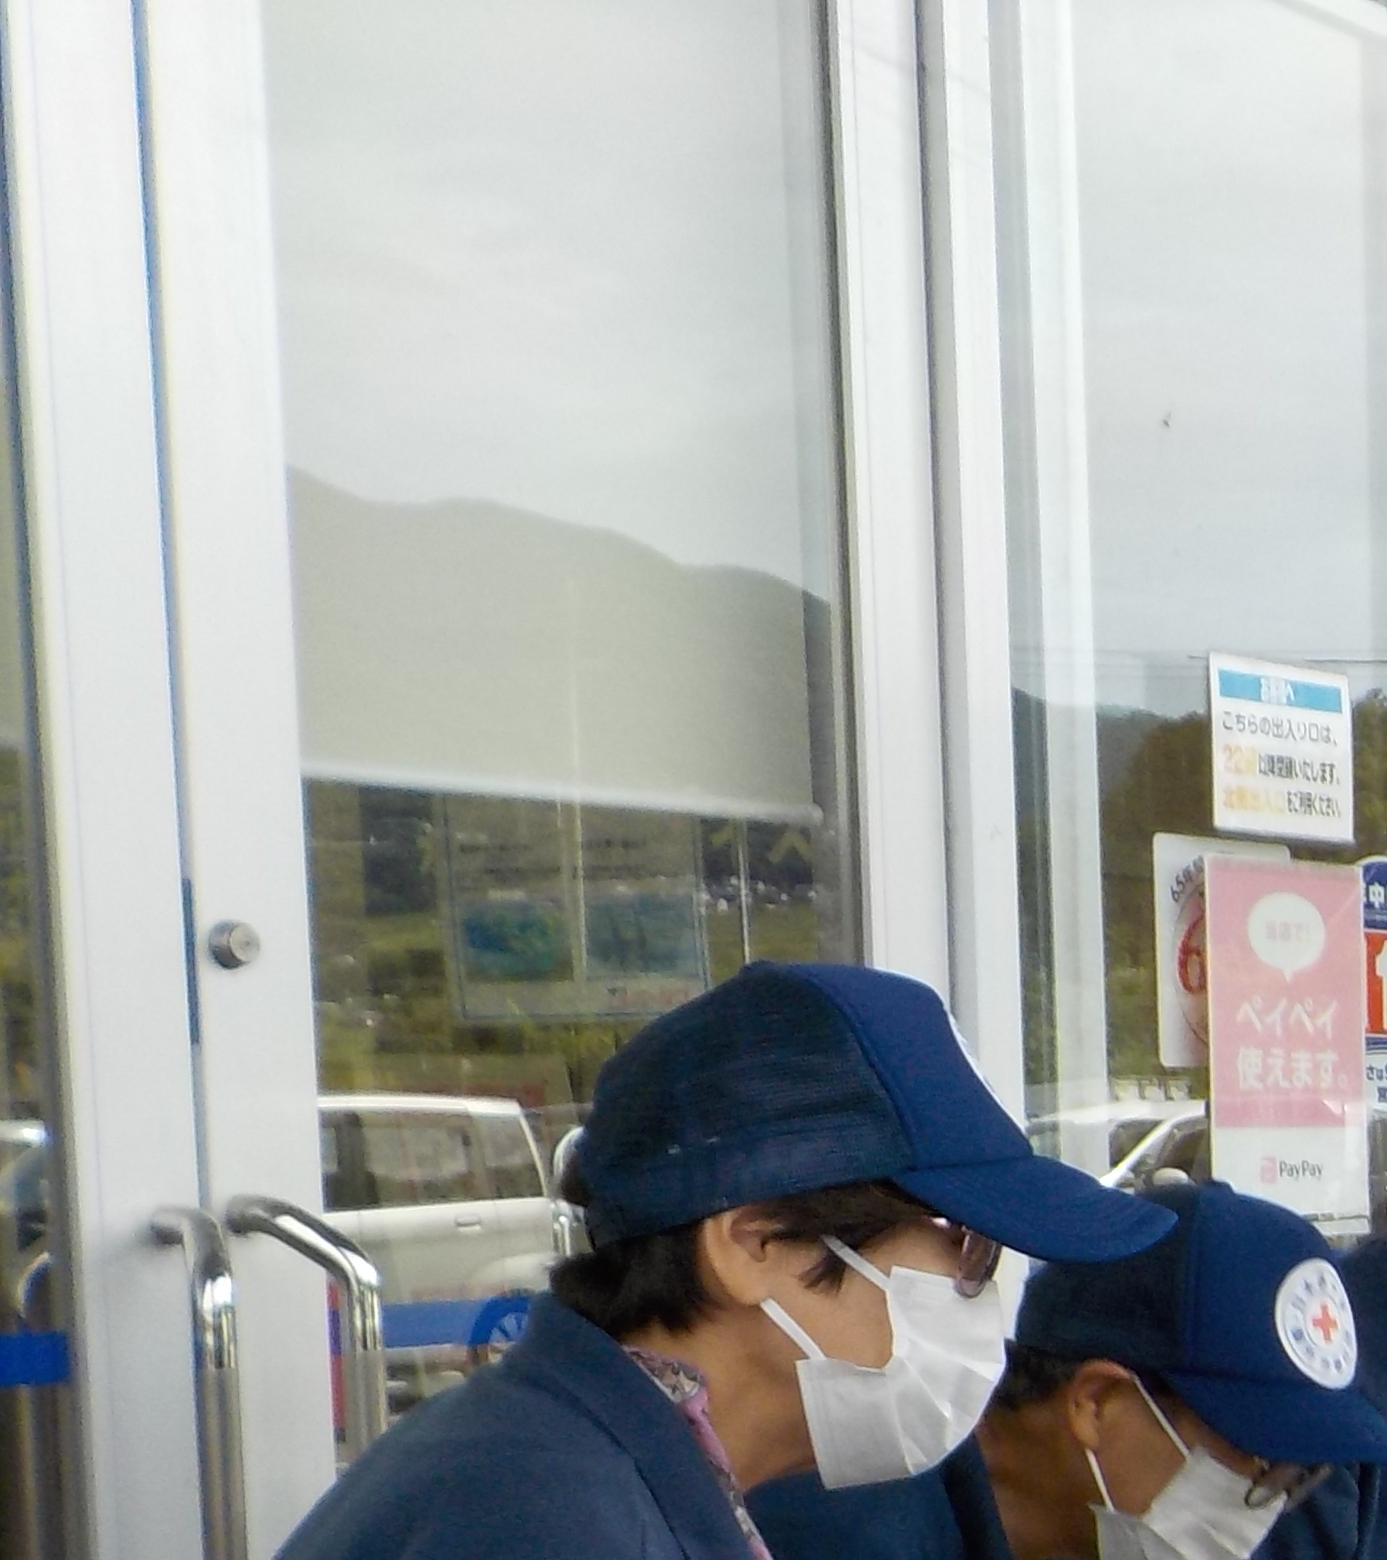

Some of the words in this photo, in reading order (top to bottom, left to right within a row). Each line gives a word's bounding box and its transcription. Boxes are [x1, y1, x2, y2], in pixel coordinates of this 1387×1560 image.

[1236, 998, 1339, 1039] ペイペイ
[1237, 1047, 1348, 1092] 使えます。
[1279, 1160, 1324, 1179] PayPay
